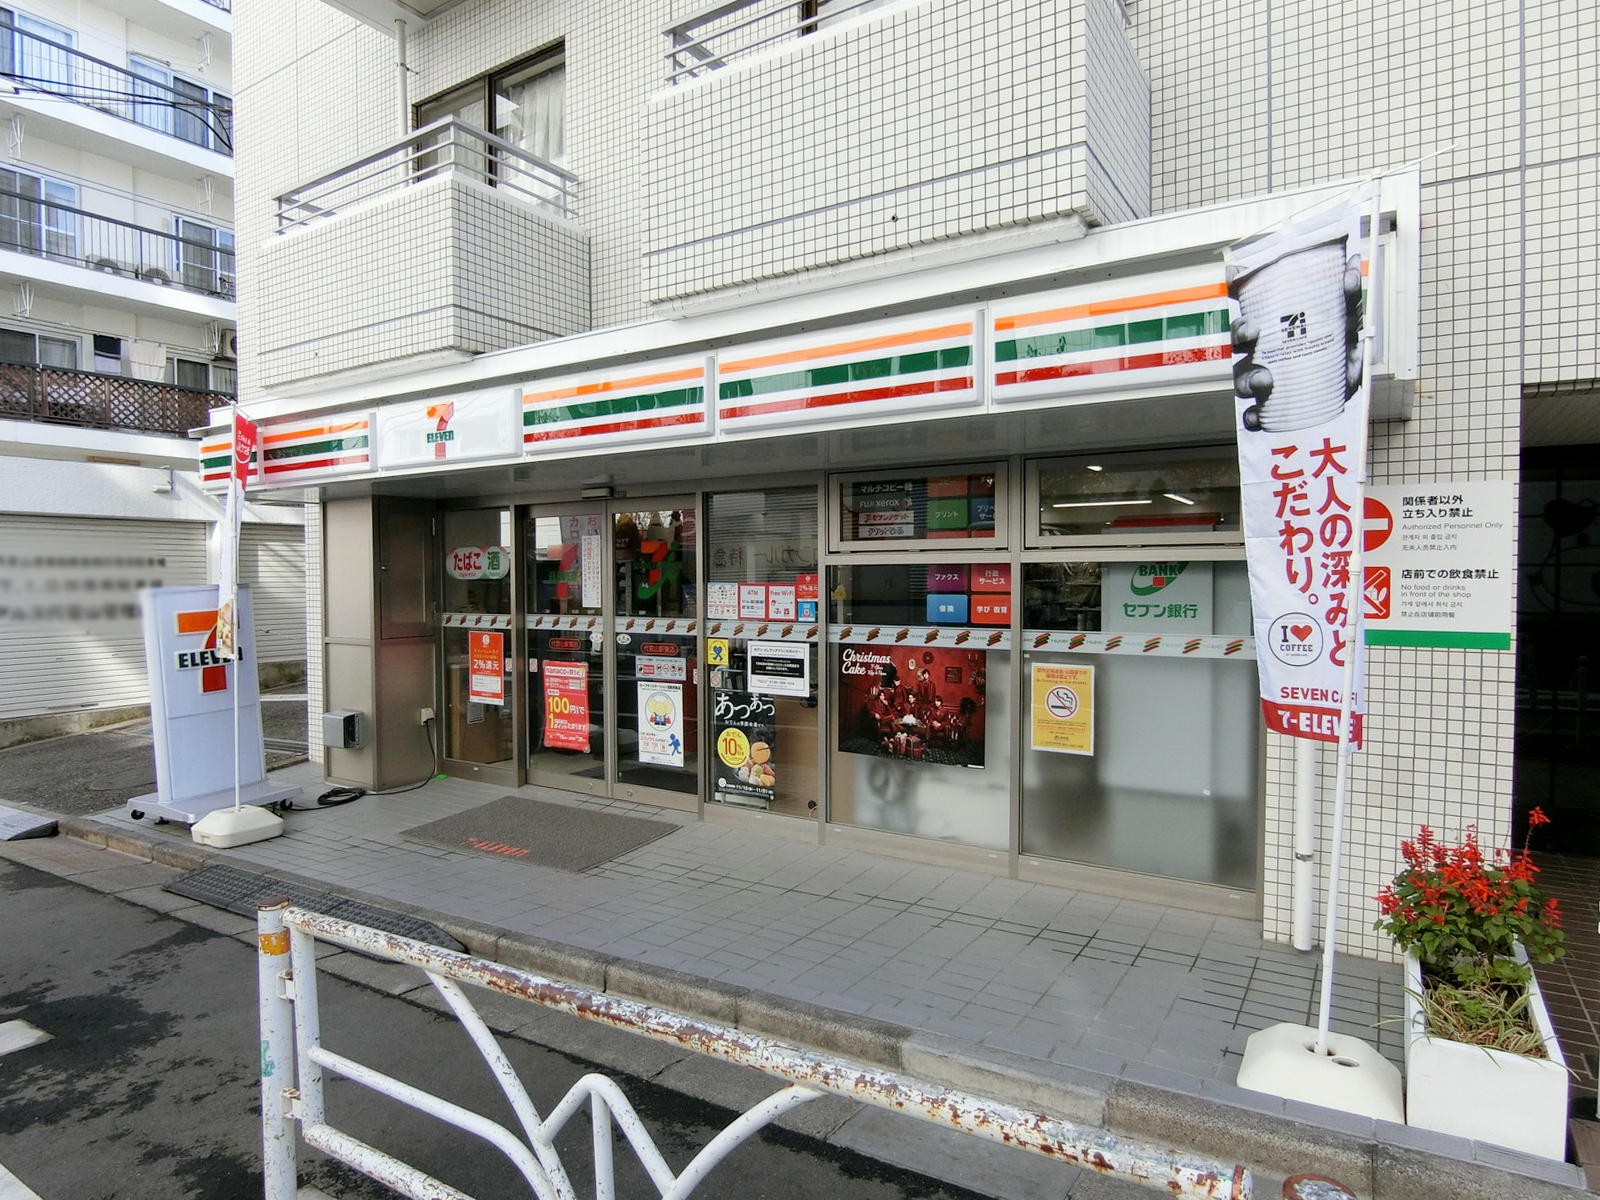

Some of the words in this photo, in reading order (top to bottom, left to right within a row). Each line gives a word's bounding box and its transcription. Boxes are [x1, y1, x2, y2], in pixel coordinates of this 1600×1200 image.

[1402, 494, 1464, 506] 関係者以外
[1402, 507, 1474, 519] 立ち入り禁止
[1270, 445, 1319, 605] こだわり。
[1484, 521, 1503, 529] Only
[1309, 437, 1353, 667] 大人の深みと
[453, 551, 482, 571] たばこ
[487, 551, 500, 570] 酒
[1138, 564, 1179, 577] BANK
[1401, 568, 1500, 580] 店前での飲食禁止
[1122, 602, 1199, 619] セブン銀行
[842, 648, 891, 663] Christmas
[1280, 644, 1313, 652] COFFEE
[841, 660, 866, 675] Cake
[1280, 686, 1329, 702] SEVEN
